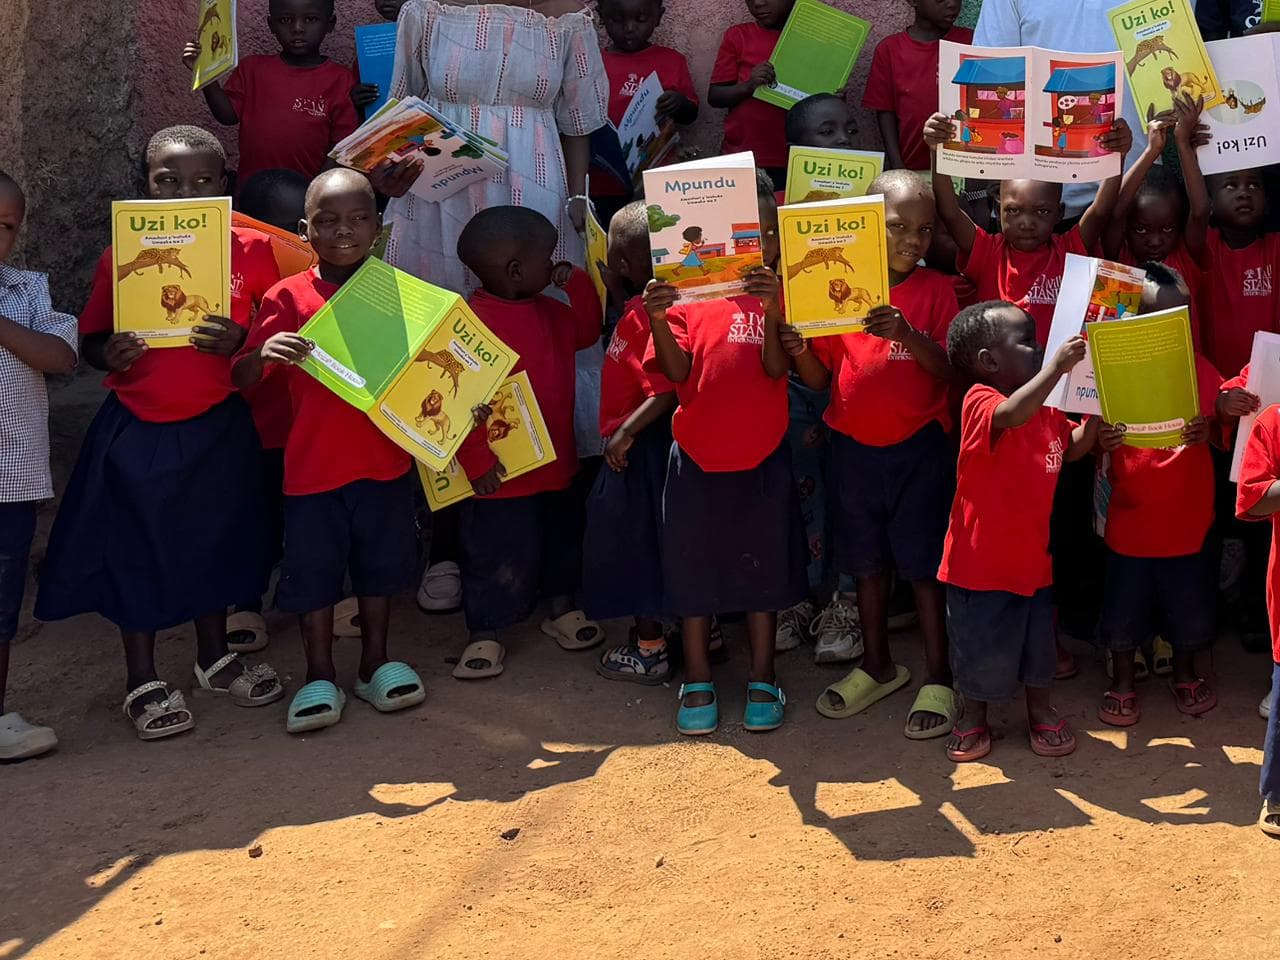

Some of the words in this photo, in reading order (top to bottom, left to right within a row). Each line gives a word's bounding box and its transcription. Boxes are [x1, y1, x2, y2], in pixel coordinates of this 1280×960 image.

[1120, 11, 1148, 31] Uzi
[1150, 0, 1175, 21] ko!
[1216, 140, 1240, 155] ko!
[1244, 134, 1268, 148] Uzi
[803, 160, 832, 178] Uzi
[837, 164, 864, 181] ko!
[664, 176, 736, 195] Mpundu
[129, 215, 165, 232] Uzi
[173, 213, 207, 231] ko!
[796, 219, 830, 236] Uzi
[836, 215, 867, 233] ko!
[728, 324, 765, 339] STAN
[451, 317, 475, 345] Uzi
[474, 339, 500, 368] ko!
